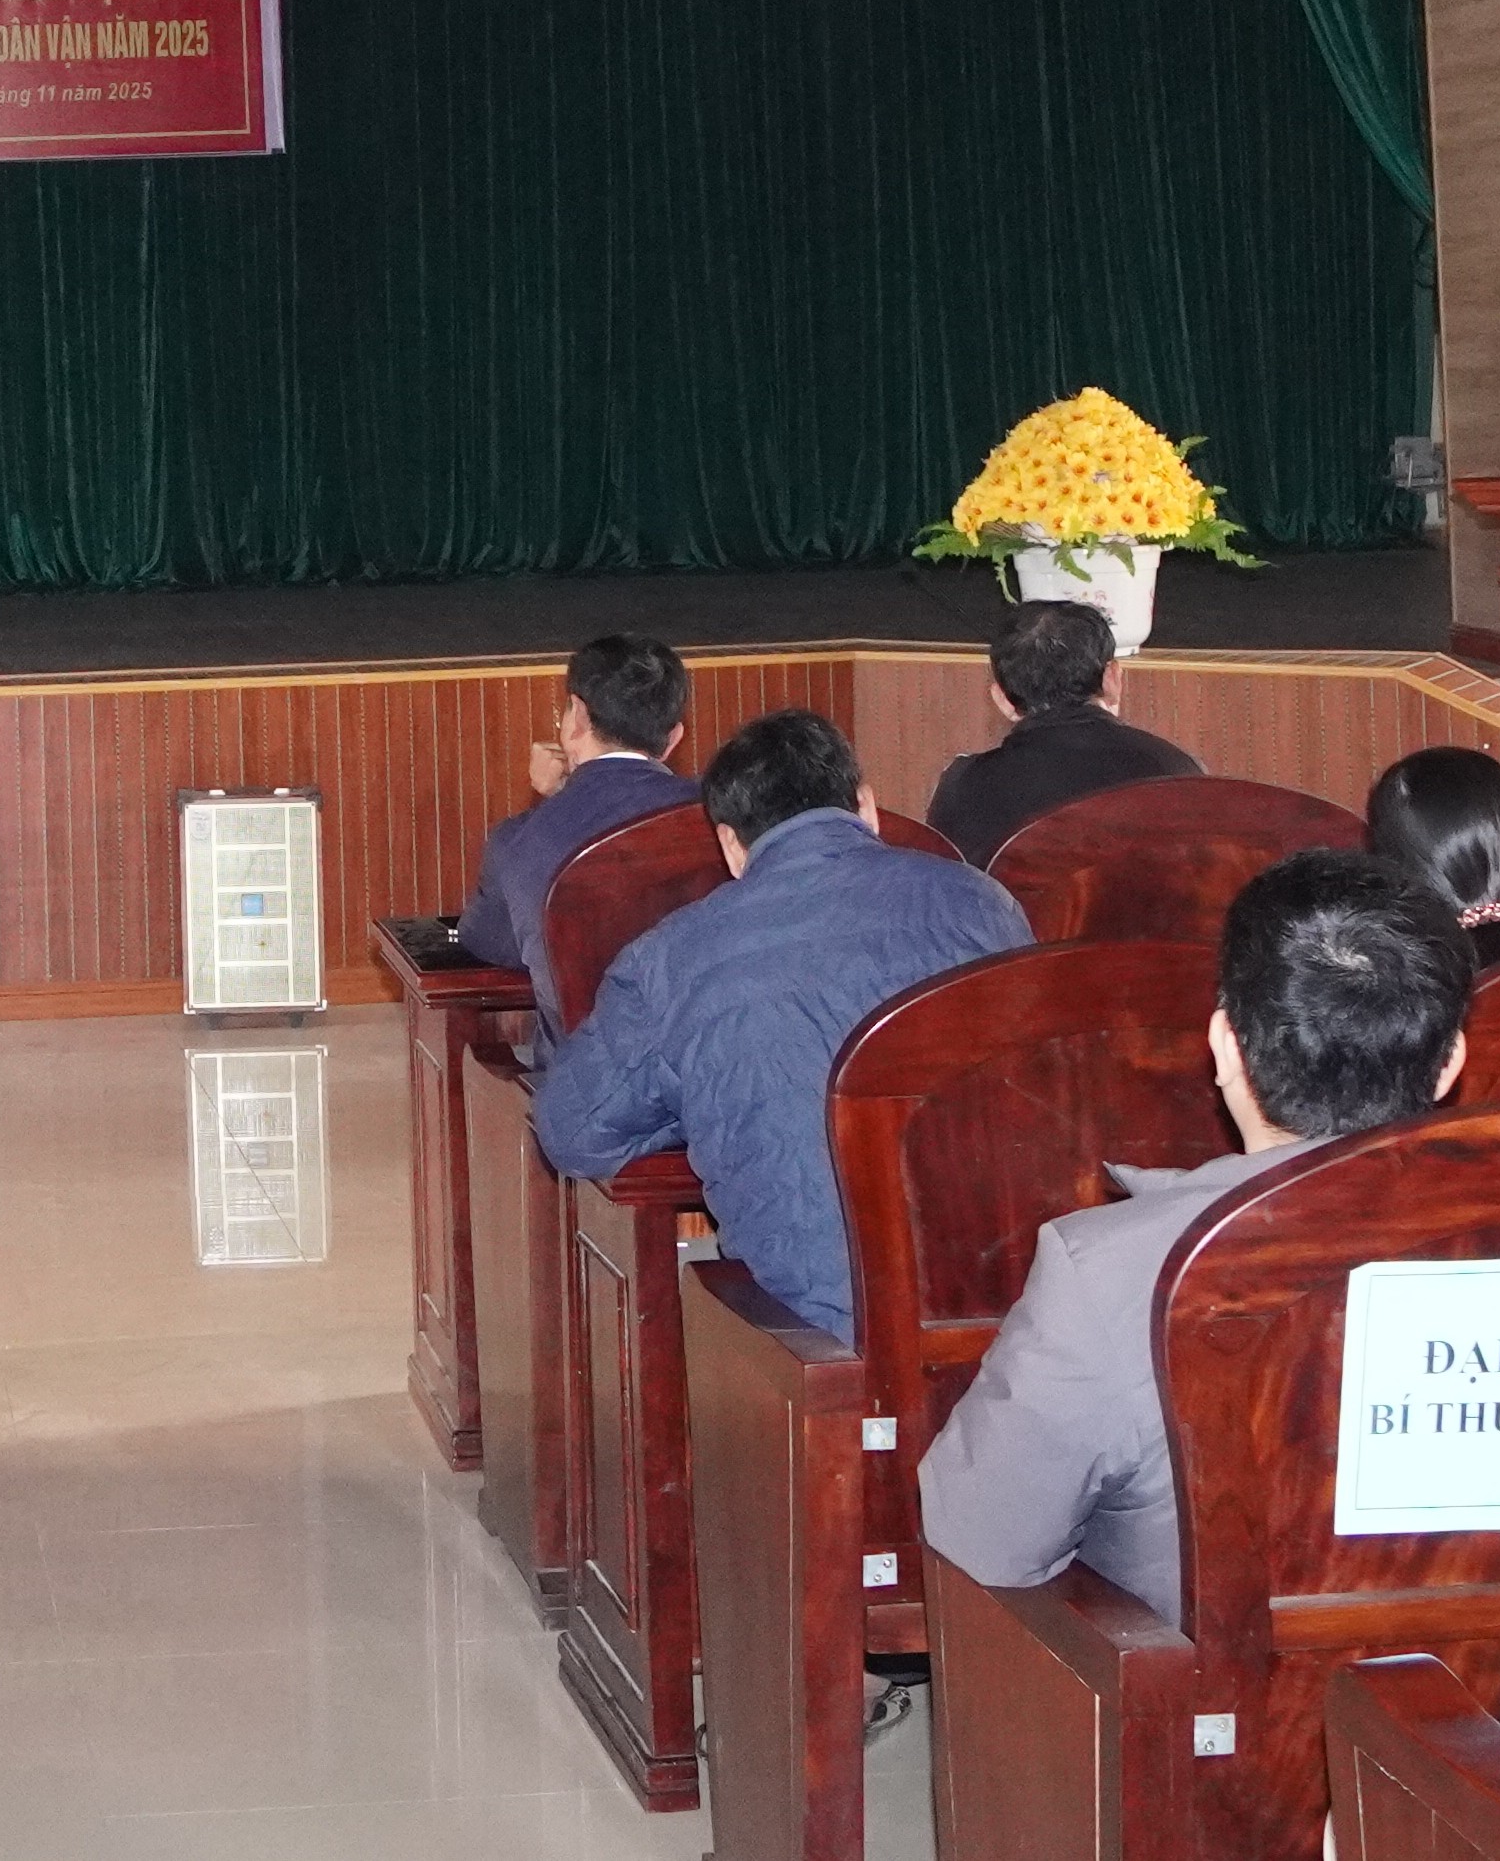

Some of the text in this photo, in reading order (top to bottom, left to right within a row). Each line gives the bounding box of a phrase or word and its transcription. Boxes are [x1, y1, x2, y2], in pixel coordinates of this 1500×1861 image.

[47, 15, 92, 69] VẬN
[97, 13, 149, 59] NĂM
[155, 19, 209, 58] 2025
[37, 84, 56, 103] 11
[61, 84, 102, 102] năm
[108, 82, 153, 101] 2025
[1369, 1393, 1411, 1436] BÍ
